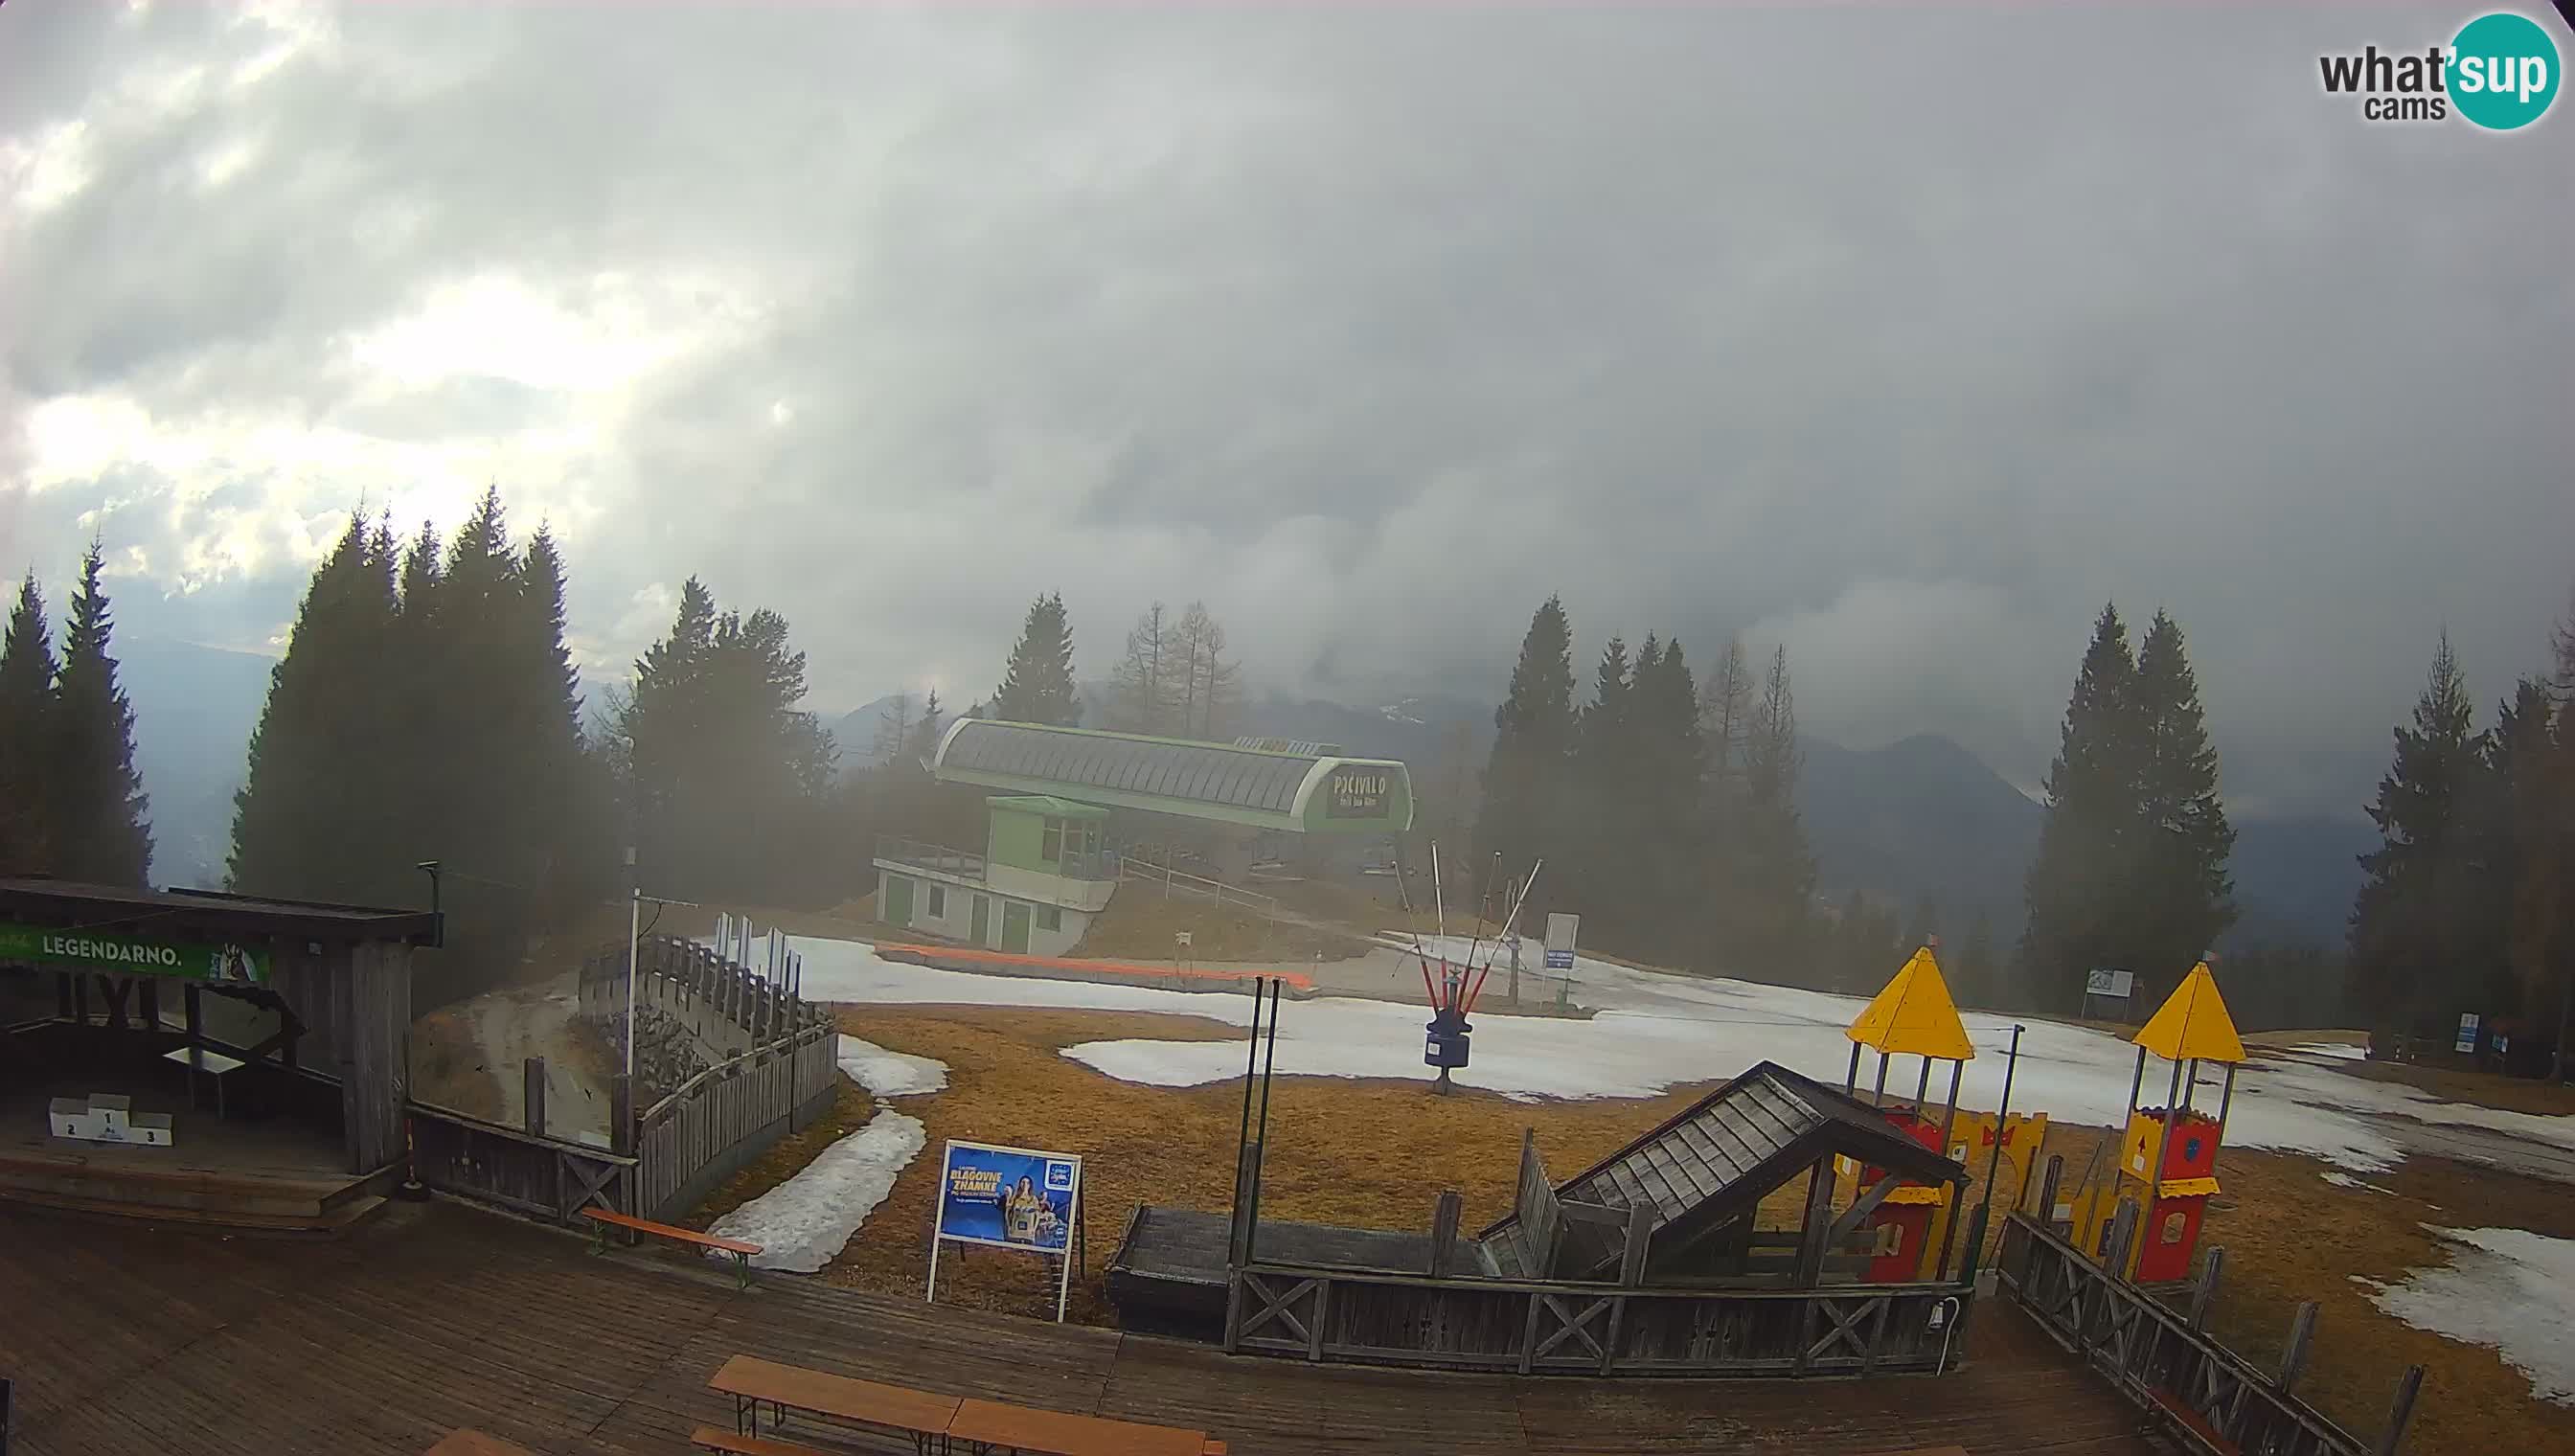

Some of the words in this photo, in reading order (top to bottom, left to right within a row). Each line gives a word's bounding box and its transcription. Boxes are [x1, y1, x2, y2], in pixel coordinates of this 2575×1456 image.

[42, 935, 183, 967] LEGENDARNO.
[105, 1112, 111, 1124] 1
[67, 1125, 75, 1135] 2
[148, 1131, 154, 1142] 3
[950, 1169, 1003, 1183] BLAGOVNE
[953, 1179, 998, 1192] ZNAMKE
